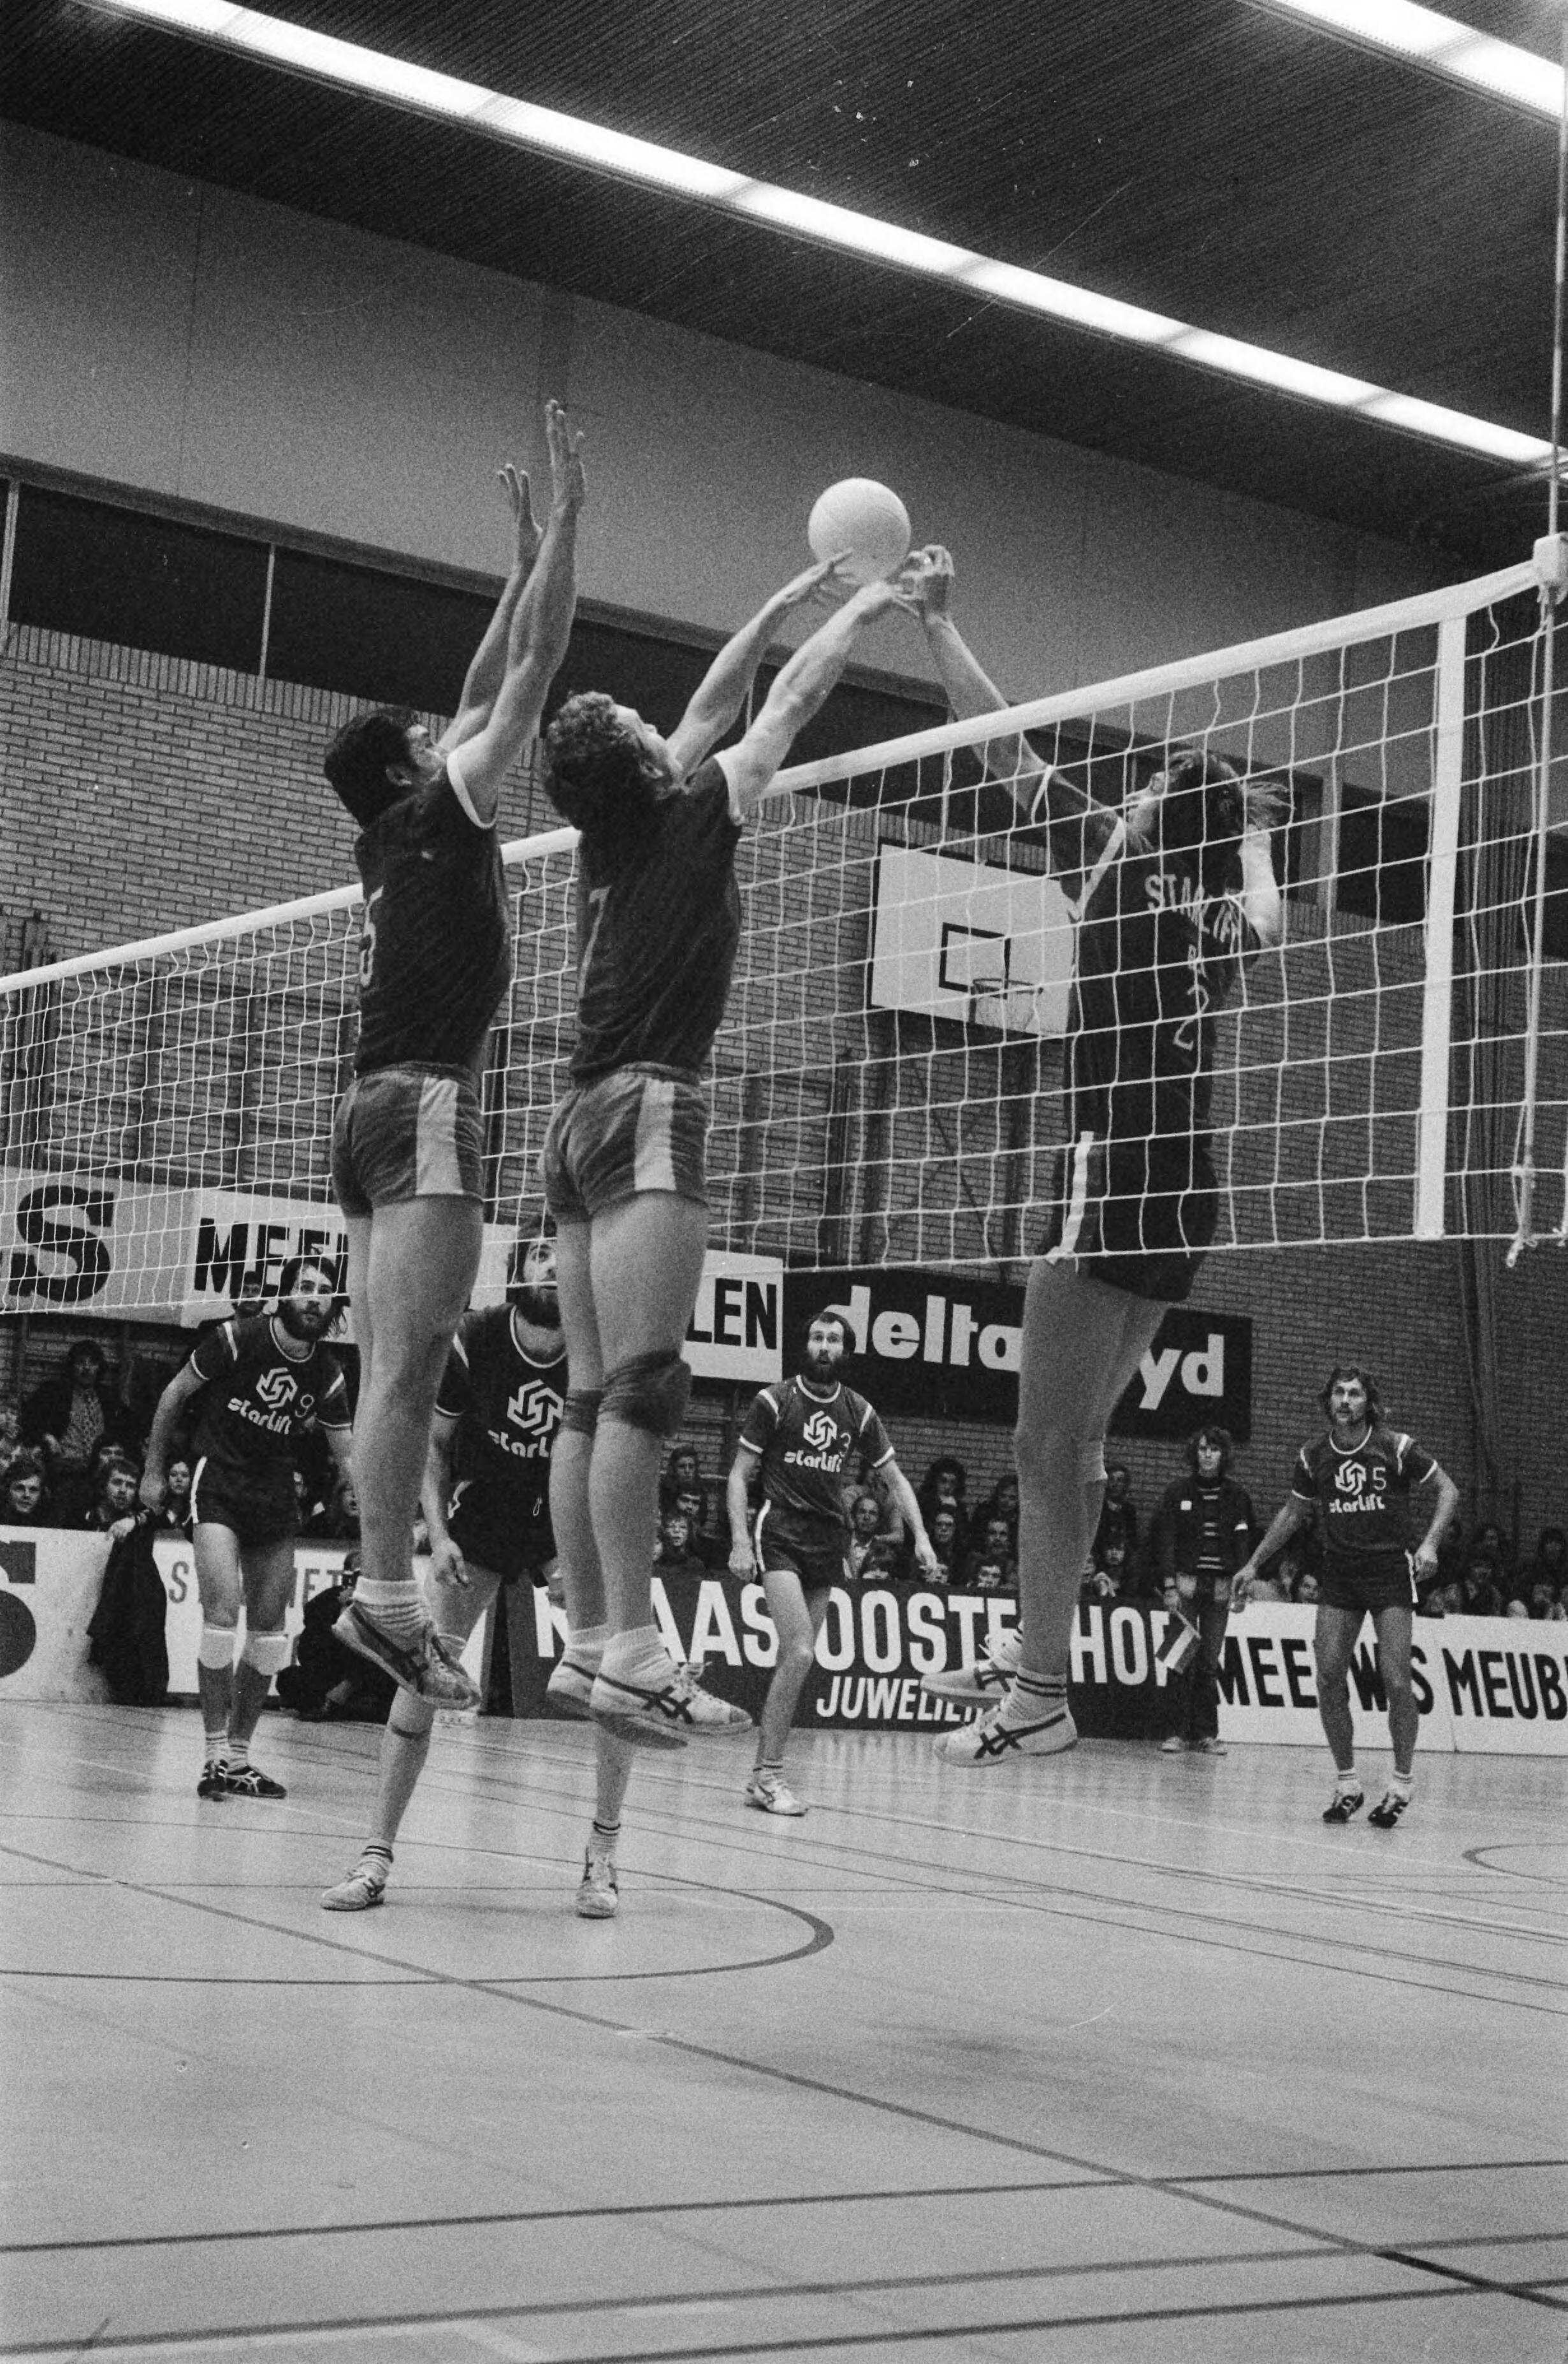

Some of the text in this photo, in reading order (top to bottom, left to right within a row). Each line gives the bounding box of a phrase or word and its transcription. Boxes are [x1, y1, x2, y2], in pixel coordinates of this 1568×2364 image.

[578, 887, 613, 999] 7
[1173, 985, 1210, 1050] 2
[194, 1217, 350, 1308] ME
[824, 1285, 1024, 1372] delta
[294, 1394, 315, 1418] 9
[488, 1430, 549, 1458] starl
[784, 1449, 842, 1472] starlift
[839, 1432, 852, 1458] 3
[1373, 1467, 1387, 1491] 5
[1329, 1493, 1386, 1513] starlift
[533, 1577, 1170, 1686] KAAS OOSTEHO
[817, 1676, 983, 1722] JUWELI
[1216, 1636, 1568, 1720] MEEWS MEUB
